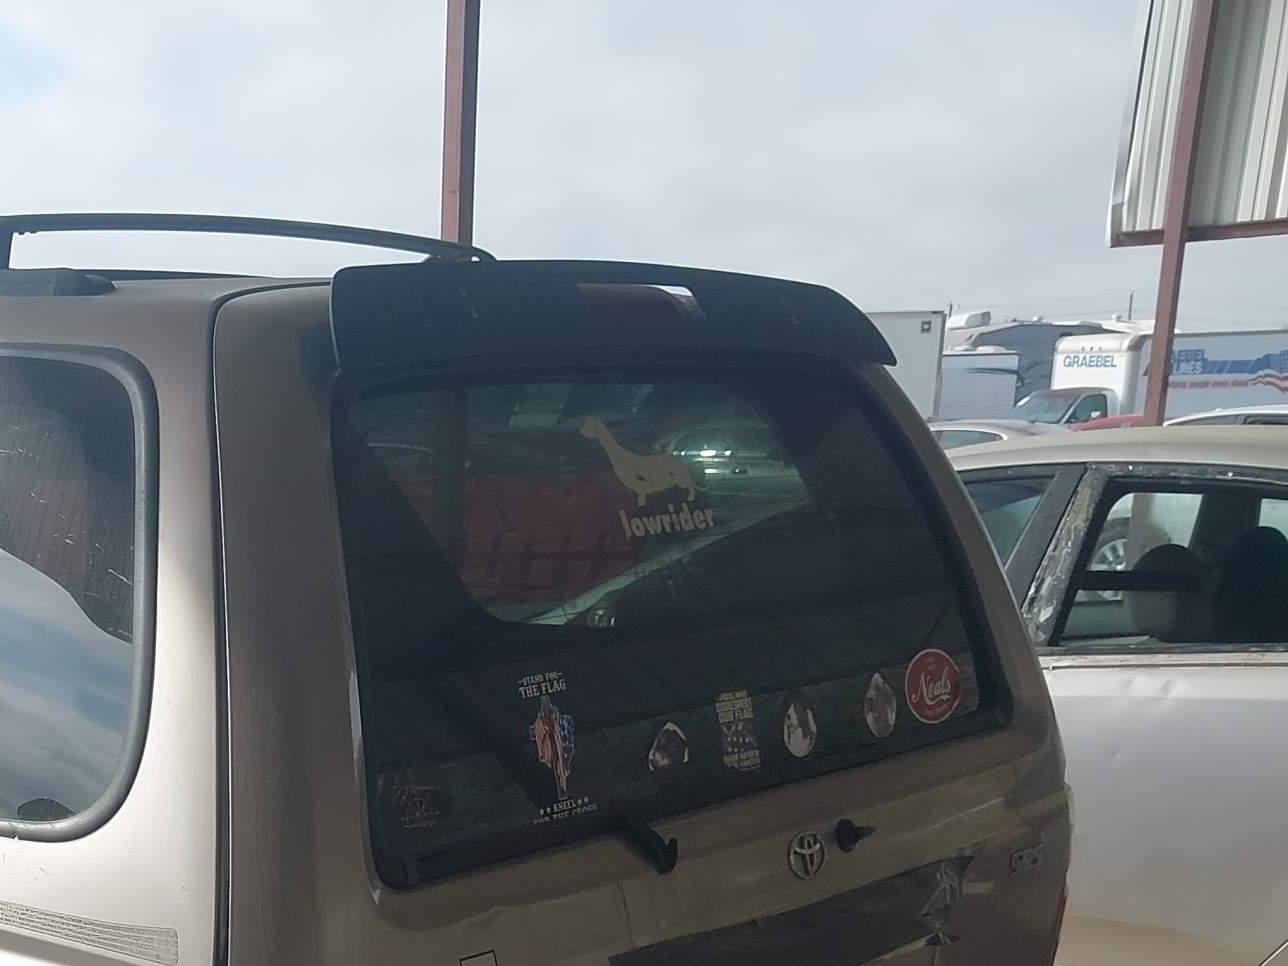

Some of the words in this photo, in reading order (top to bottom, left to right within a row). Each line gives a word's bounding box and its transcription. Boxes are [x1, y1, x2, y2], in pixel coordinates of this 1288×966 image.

[1063, 355, 1117, 368] GRAEBEL
[617, 503, 715, 543] lowrider
[519, 684, 540, 699] THE
[541, 679, 567, 695] FLAG
[553, 799, 577, 813] KNEEL
